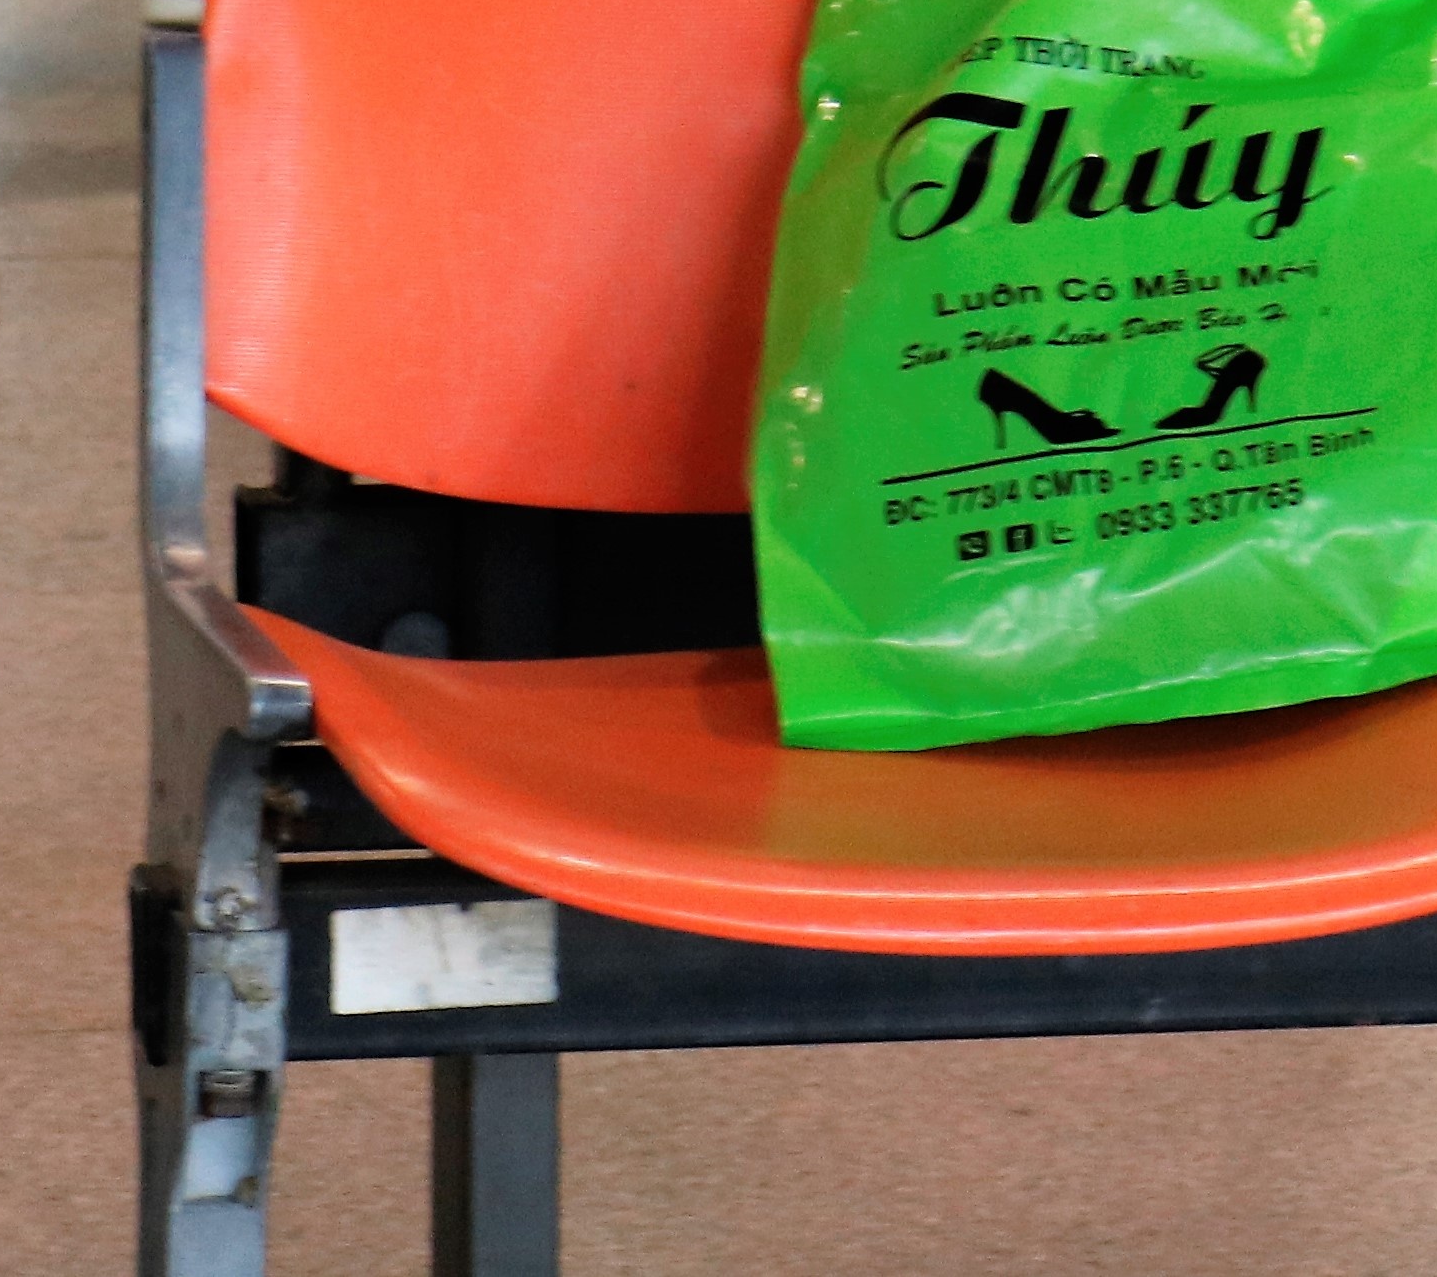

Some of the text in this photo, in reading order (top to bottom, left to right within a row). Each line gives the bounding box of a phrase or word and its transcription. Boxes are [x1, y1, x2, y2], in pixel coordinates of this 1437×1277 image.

[878, 91, 1333, 241] Thúy
[933, 282, 1043, 317] Luôn
[1060, 277, 1115, 303] Có
[945, 482, 1021, 515] 773/4
[1096, 475, 1305, 542] 0933 337765
